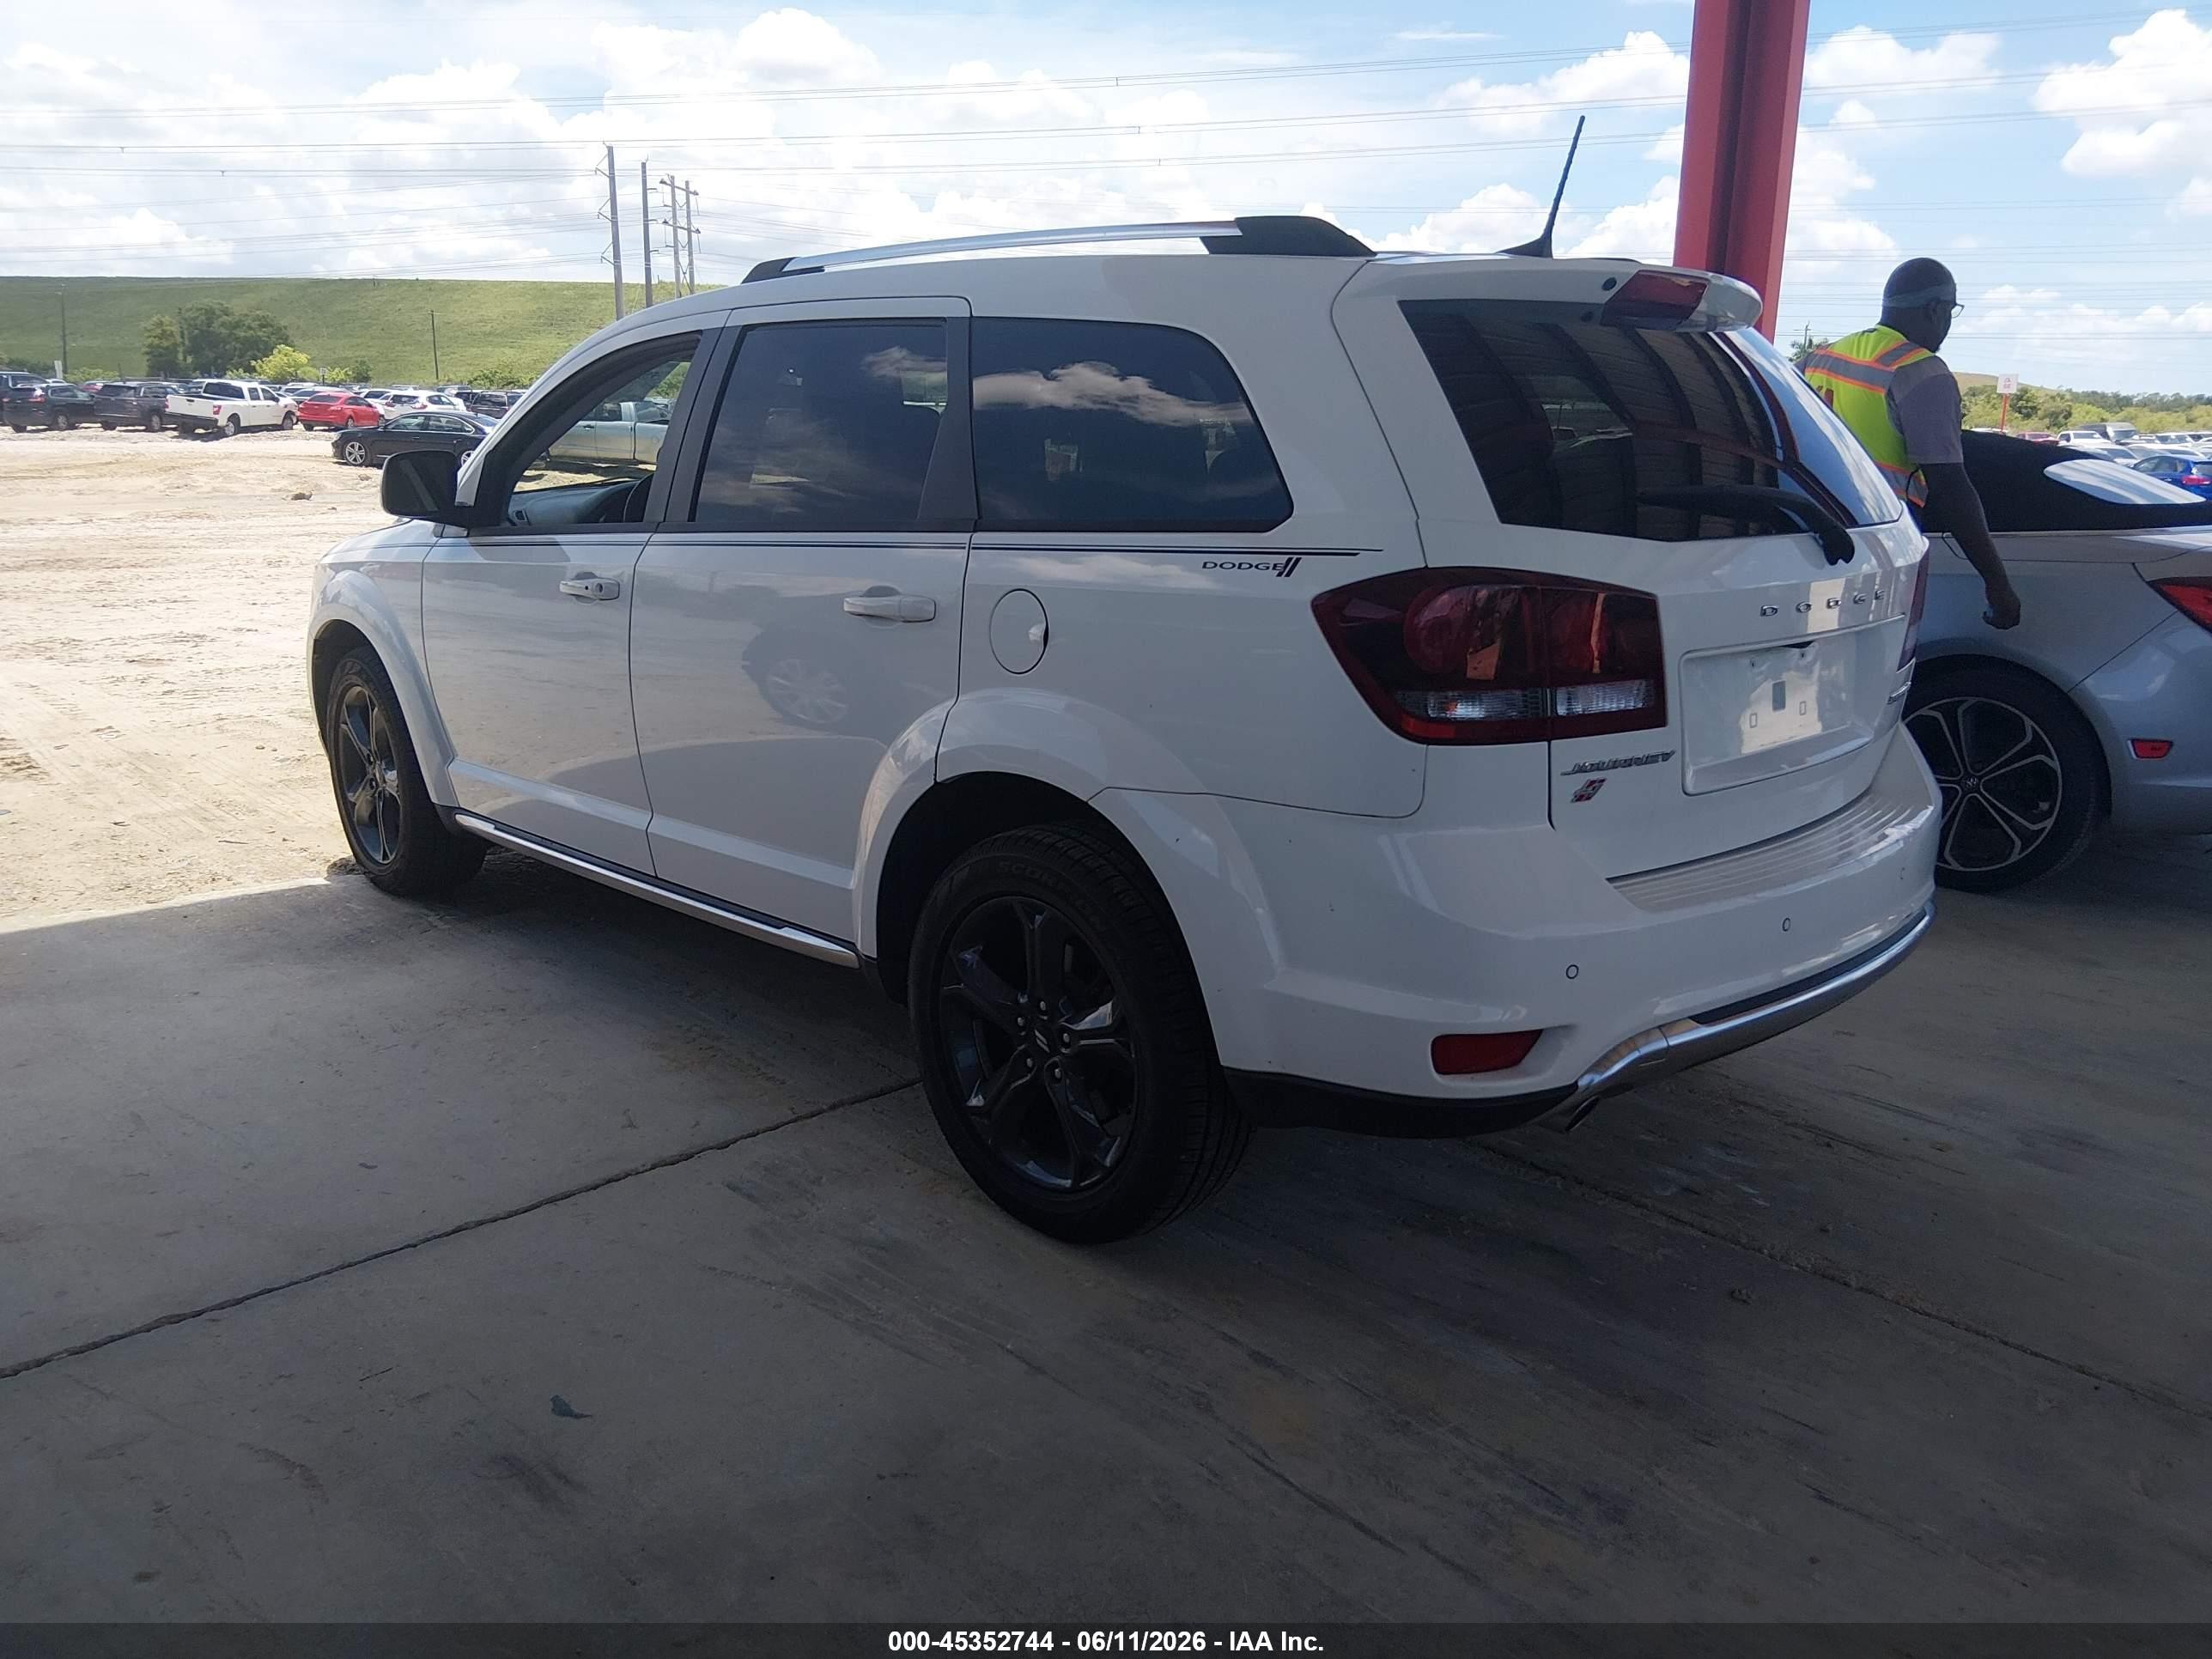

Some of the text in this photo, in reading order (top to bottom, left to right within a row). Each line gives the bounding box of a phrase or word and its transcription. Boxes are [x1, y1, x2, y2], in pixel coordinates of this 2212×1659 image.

[1202, 561, 1285, 571] DODGE
[1760, 590, 1885, 617] DODGE
[1560, 749, 1676, 776] JOURNEY
